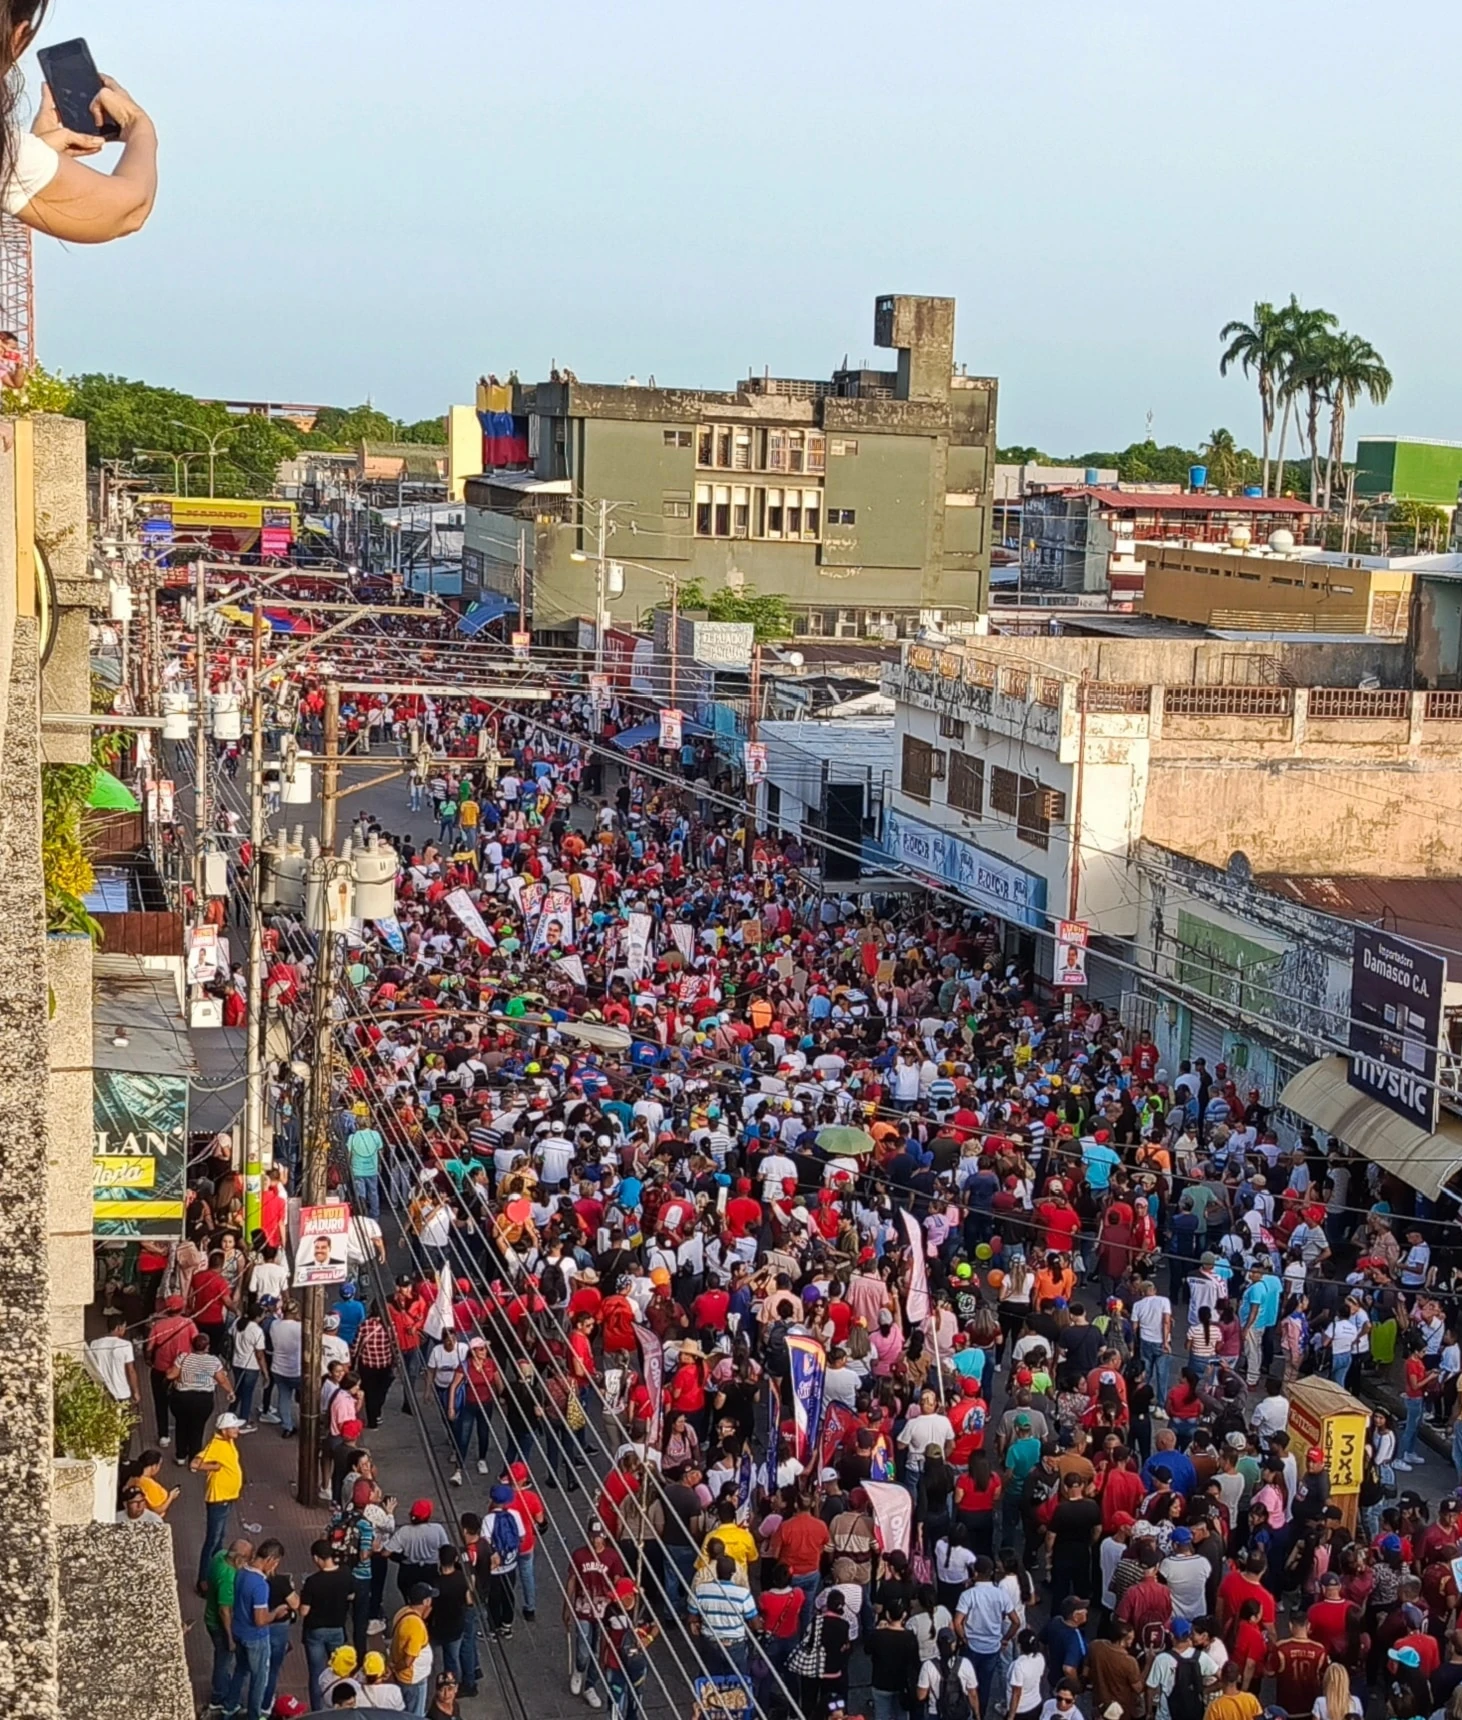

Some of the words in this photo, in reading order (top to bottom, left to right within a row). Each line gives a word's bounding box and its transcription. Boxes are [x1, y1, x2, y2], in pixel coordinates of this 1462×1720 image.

[1363, 948, 1411, 988] Damasco
[1412, 974, 1430, 998] C.A.
[93, 1131, 171, 1156] LAN
[1340, 1434, 1356, 1457] 3
